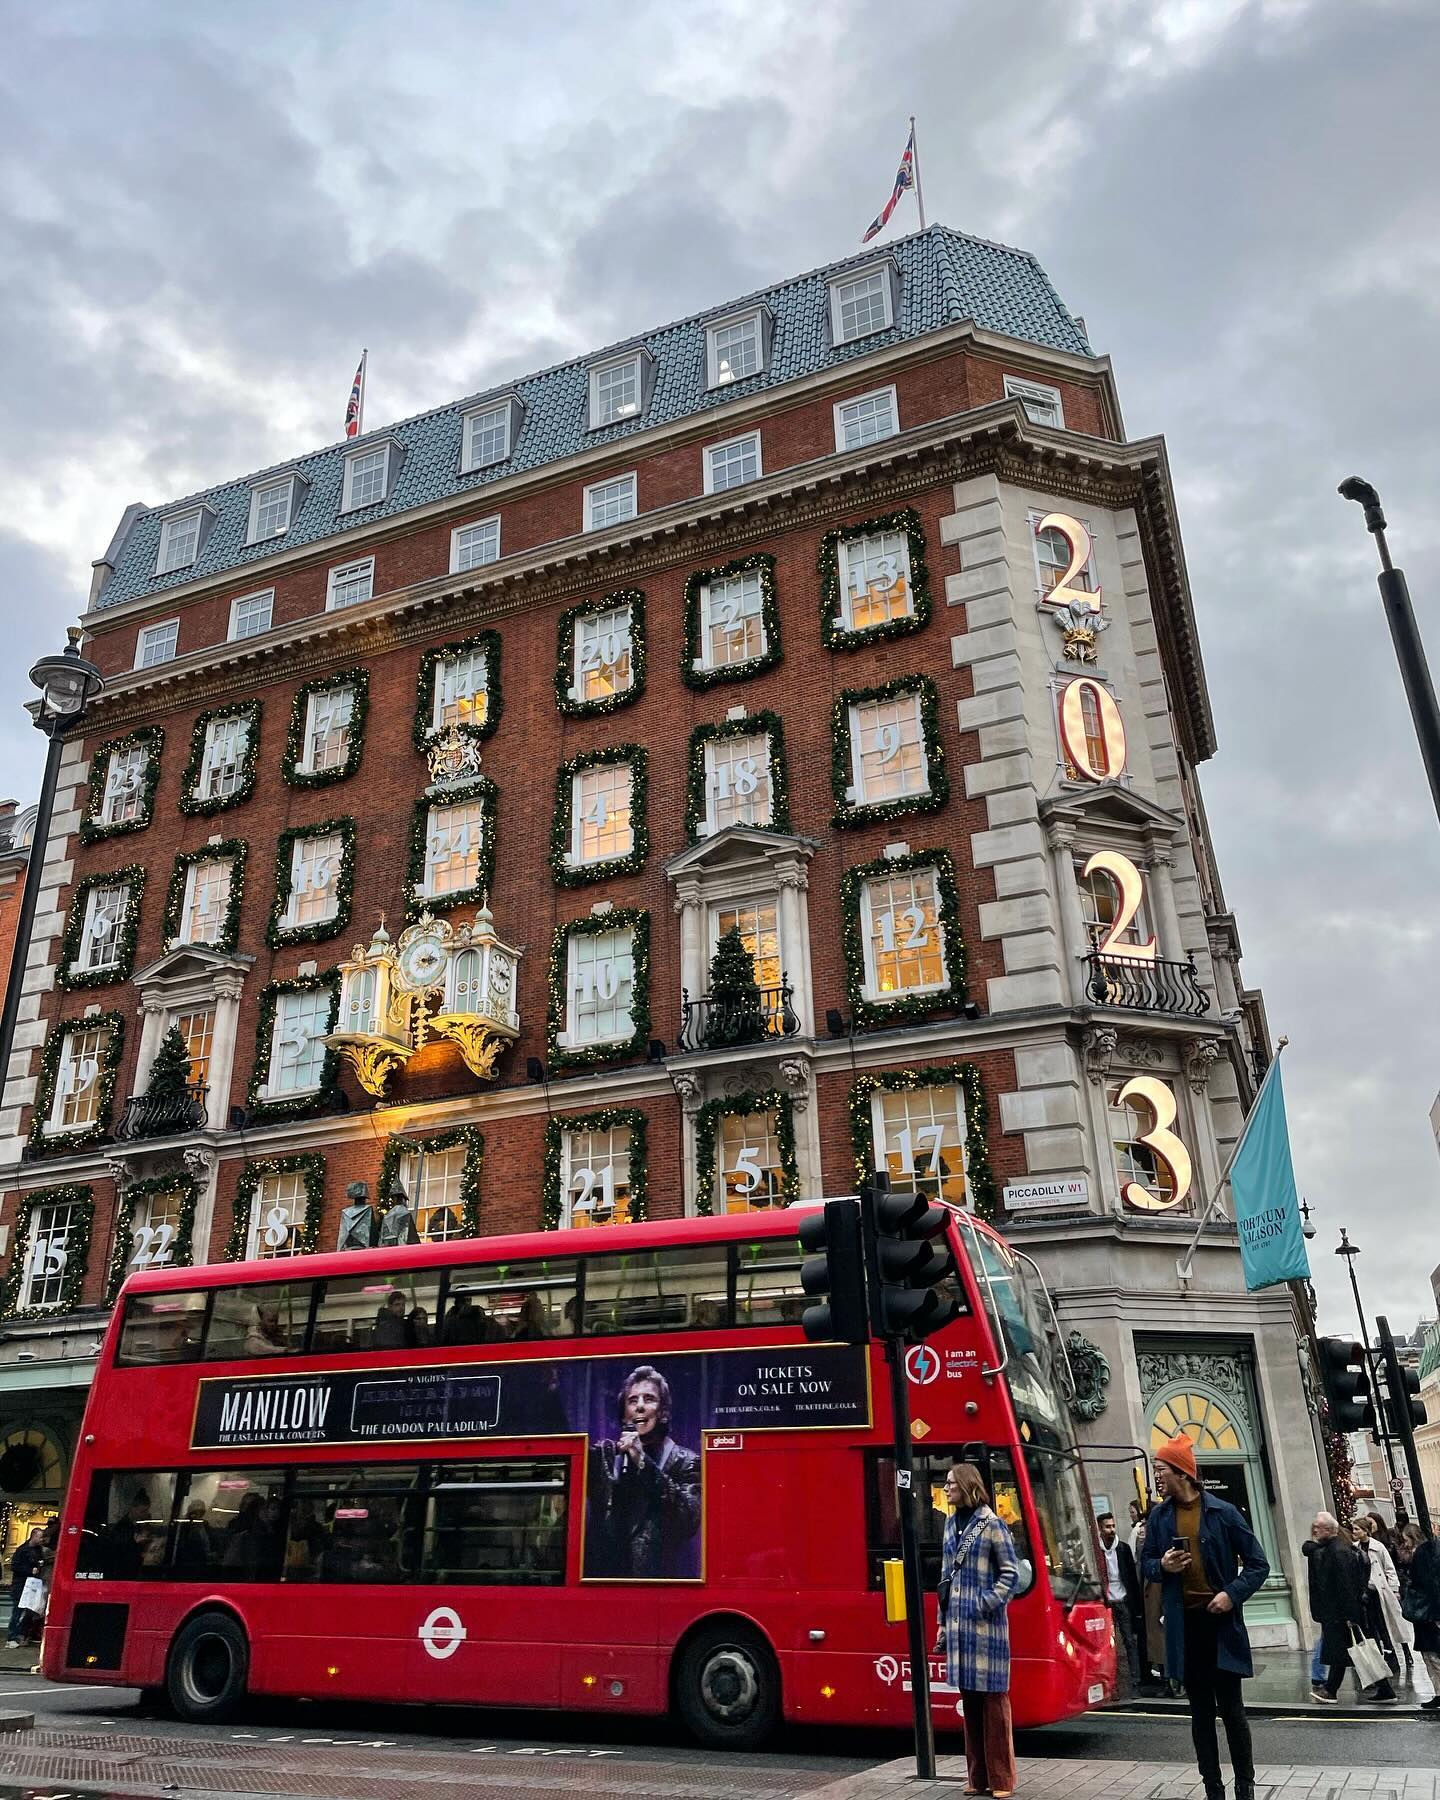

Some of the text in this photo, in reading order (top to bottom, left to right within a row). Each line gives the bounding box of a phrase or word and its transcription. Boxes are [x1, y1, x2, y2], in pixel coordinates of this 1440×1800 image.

[849, 553, 898, 600] 13
[720, 598, 745, 634] 2
[581, 631, 624, 672] 20
[441, 672, 476, 706] 14
[316, 706, 338, 743] 7
[207, 735, 237, 770] 11
[874, 725, 901, 766] 9
[106, 762, 144, 798] 23
[715, 758, 758, 800] 18
[586, 793, 608, 829] 4
[427, 823, 471, 865] 24
[295, 856, 333, 897] 16
[197, 884, 211, 917] 1
[89, 906, 117, 940] 6
[875, 906, 929, 954] 12
[579, 960, 620, 1005] 10
[286, 1025, 309, 1060] 3
[61, 1058, 99, 1096] 19
[892, 1124, 945, 1175] 17
[571, 1163, 618, 1212] 21
[734, 1147, 763, 1194] 5
[1008, 1183, 1082, 1199] PICCADILLY W1
[131, 1223, 175, 1265] 22
[264, 1206, 290, 1248] 8
[32, 1236, 69, 1275] 15
[945, 1350, 977, 1358] I am an
[946, 1360, 979, 1368] electric
[416, 1375, 446, 1384] NIGHTS
[738, 1380, 832, 1396] ON SALE NOW
[756, 1366, 813, 1380] TICKETS
[946, 1370, 963, 1378] bus
[219, 1387, 332, 1432] MANILOW
[360, 1420, 488, 1435] THE LONDON PALLADIUM
[218, 1434, 231, 1443] THE
[254, 1432, 273, 1441] LAST
[286, 1429, 327, 1441] CONCERTS
